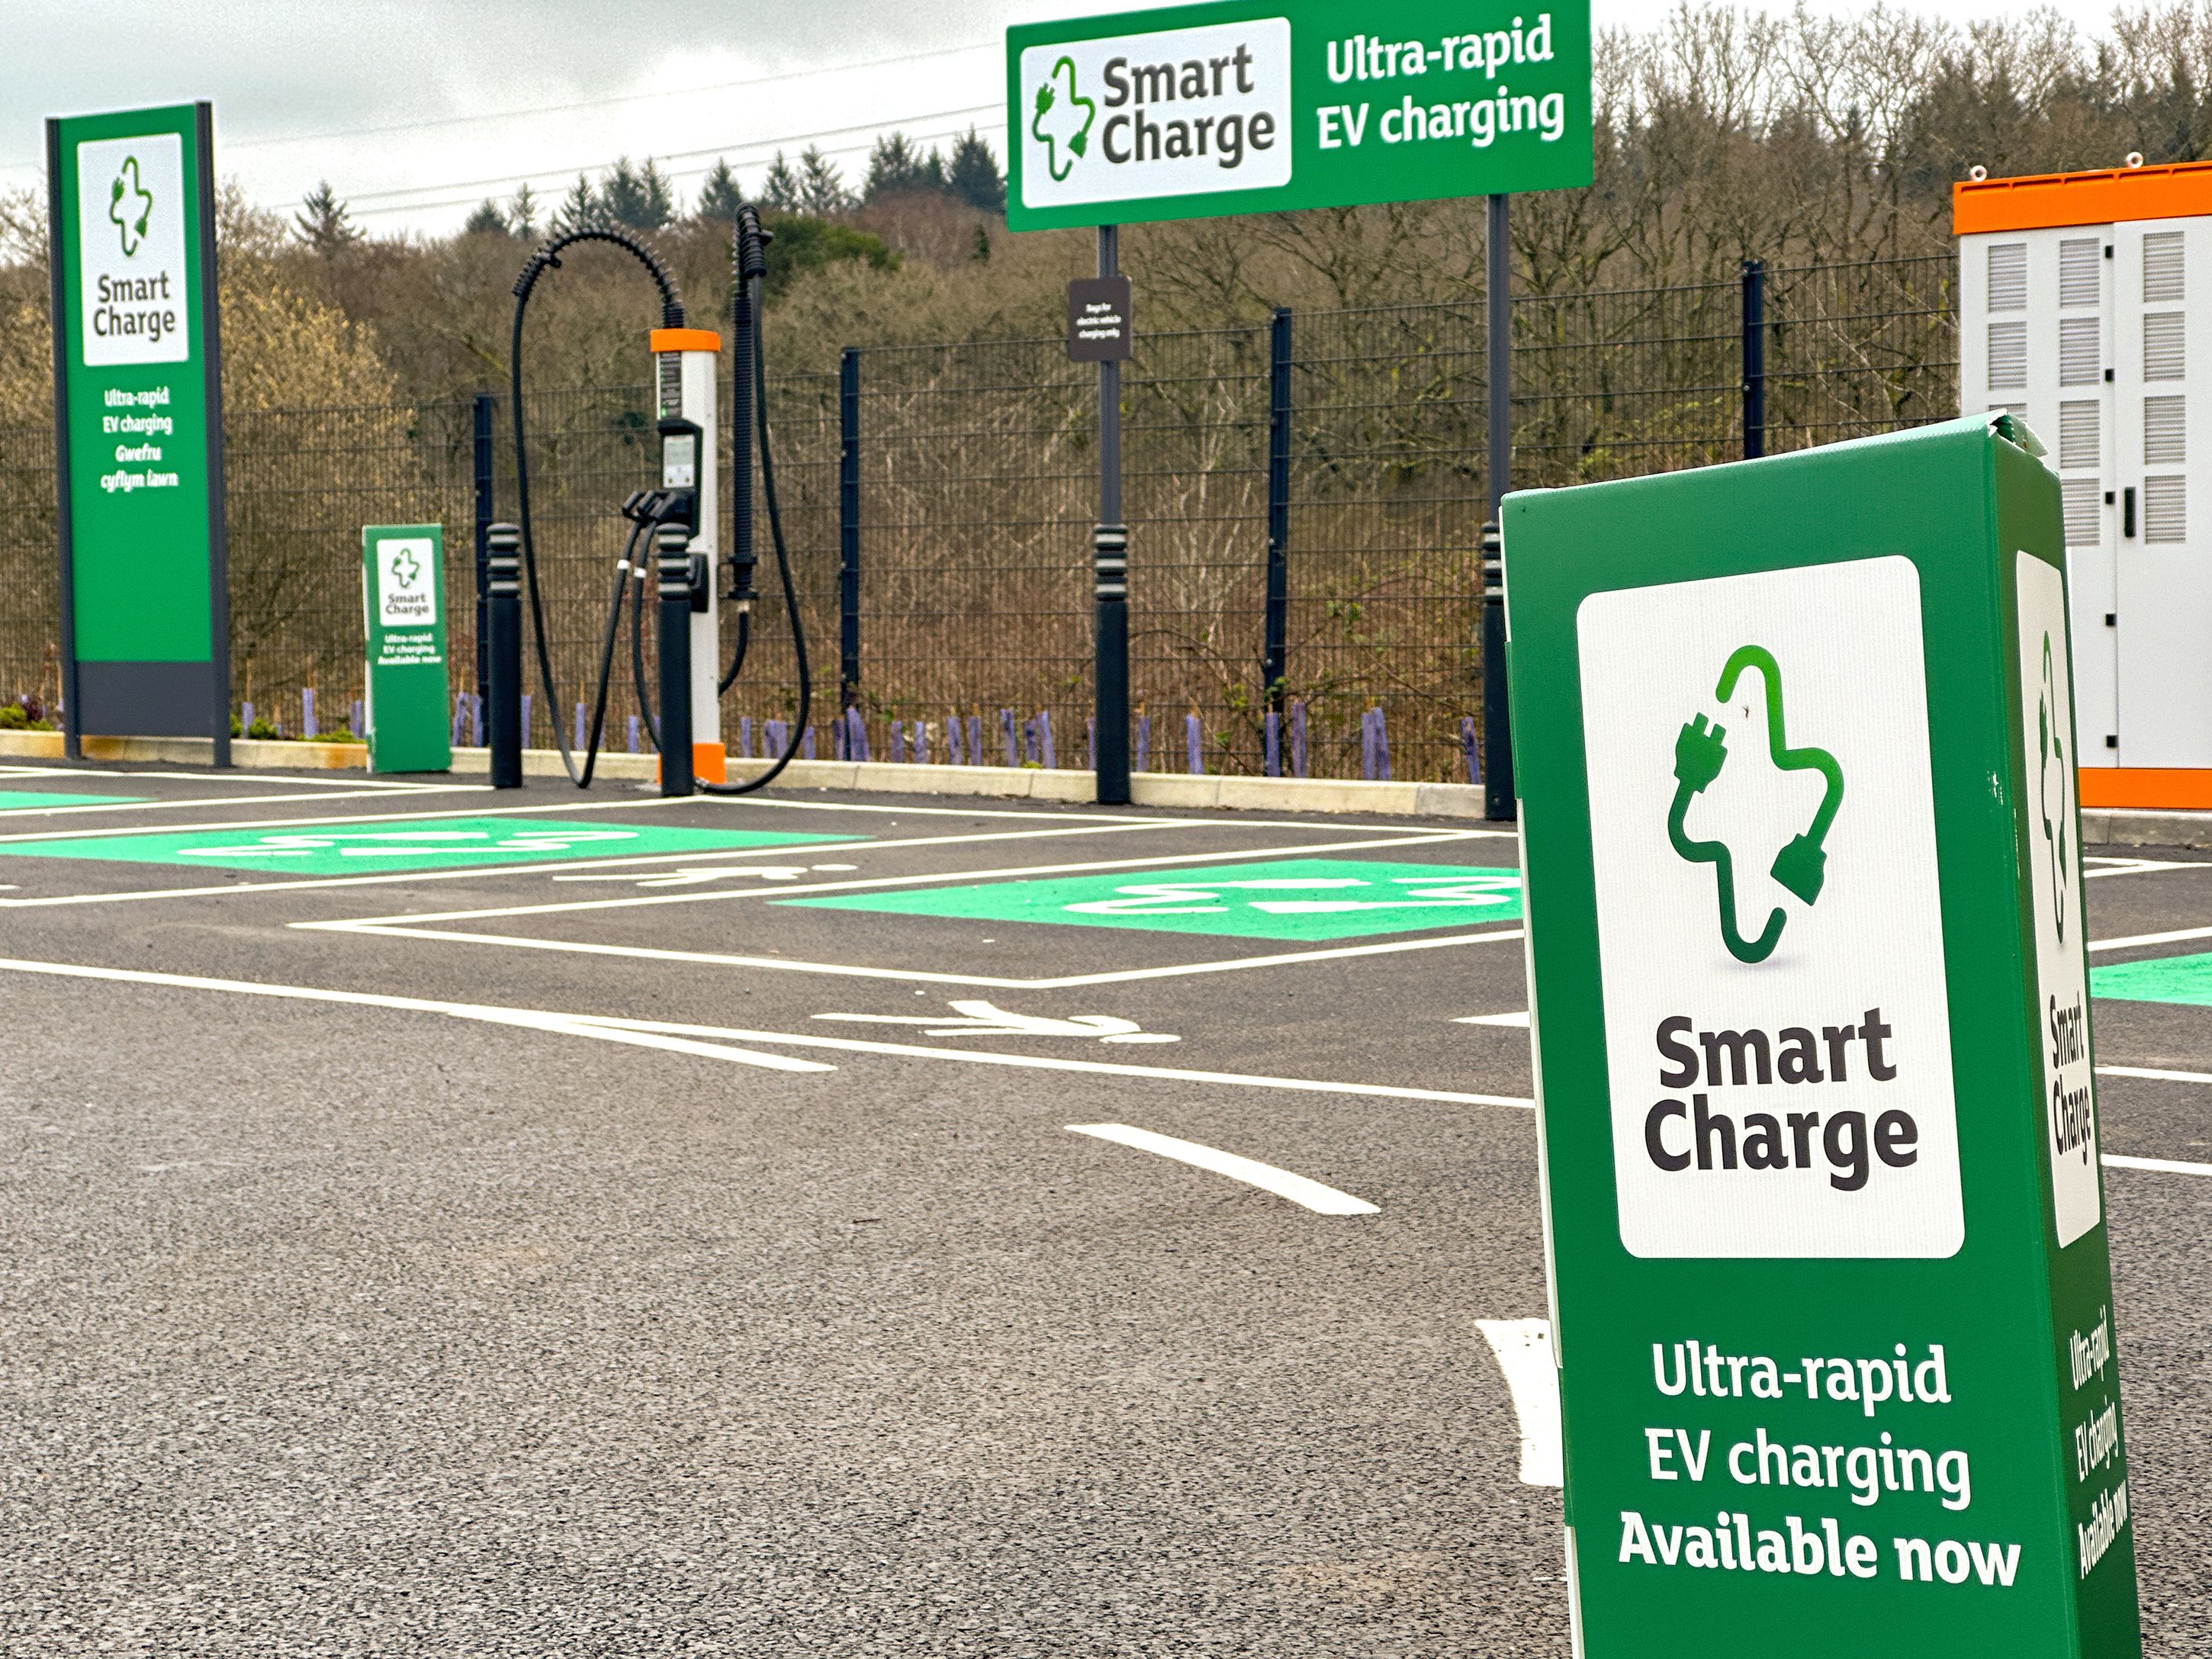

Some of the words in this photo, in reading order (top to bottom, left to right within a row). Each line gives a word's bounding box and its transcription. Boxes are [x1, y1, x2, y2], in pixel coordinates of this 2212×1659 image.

[1103, 43, 1255, 108] Smart
[1327, 13, 1554, 82] Ultra-rapid
[1102, 111, 1275, 169] Charge
[1317, 104, 1370, 150] EV
[1380, 85, 1564, 147] charging
[98, 270, 170, 303] Smart
[93, 304, 175, 342] Charge
[102, 415, 120, 433] EV
[120, 413, 173, 436] charging
[104, 386, 170, 409] Ultra-rapid
[115, 442, 162, 462] Gwefru
[385, 603, 429, 616] Charge
[387, 593, 426, 603] Smart
[1656, 1007, 1898, 1088] Smart
[2050, 990, 2085, 1069] Smart
[1645, 1093, 1918, 1191] Charge
[2053, 1073, 2091, 1166] Charge
[1652, 1340, 1952, 1417] Ultra-rapid
[2069, 1304, 2111, 1391] Ultra-rapid
[1645, 1428, 1712, 1482] EV
[1728, 1428, 1971, 1510] charging
[2075, 1420, 2089, 1483] EV
[2088, 1394, 2119, 1470] charging
[1619, 1511, 1878, 1578] Available
[1893, 1532, 2022, 1587] now
[2079, 1487, 2116, 1580] Available
